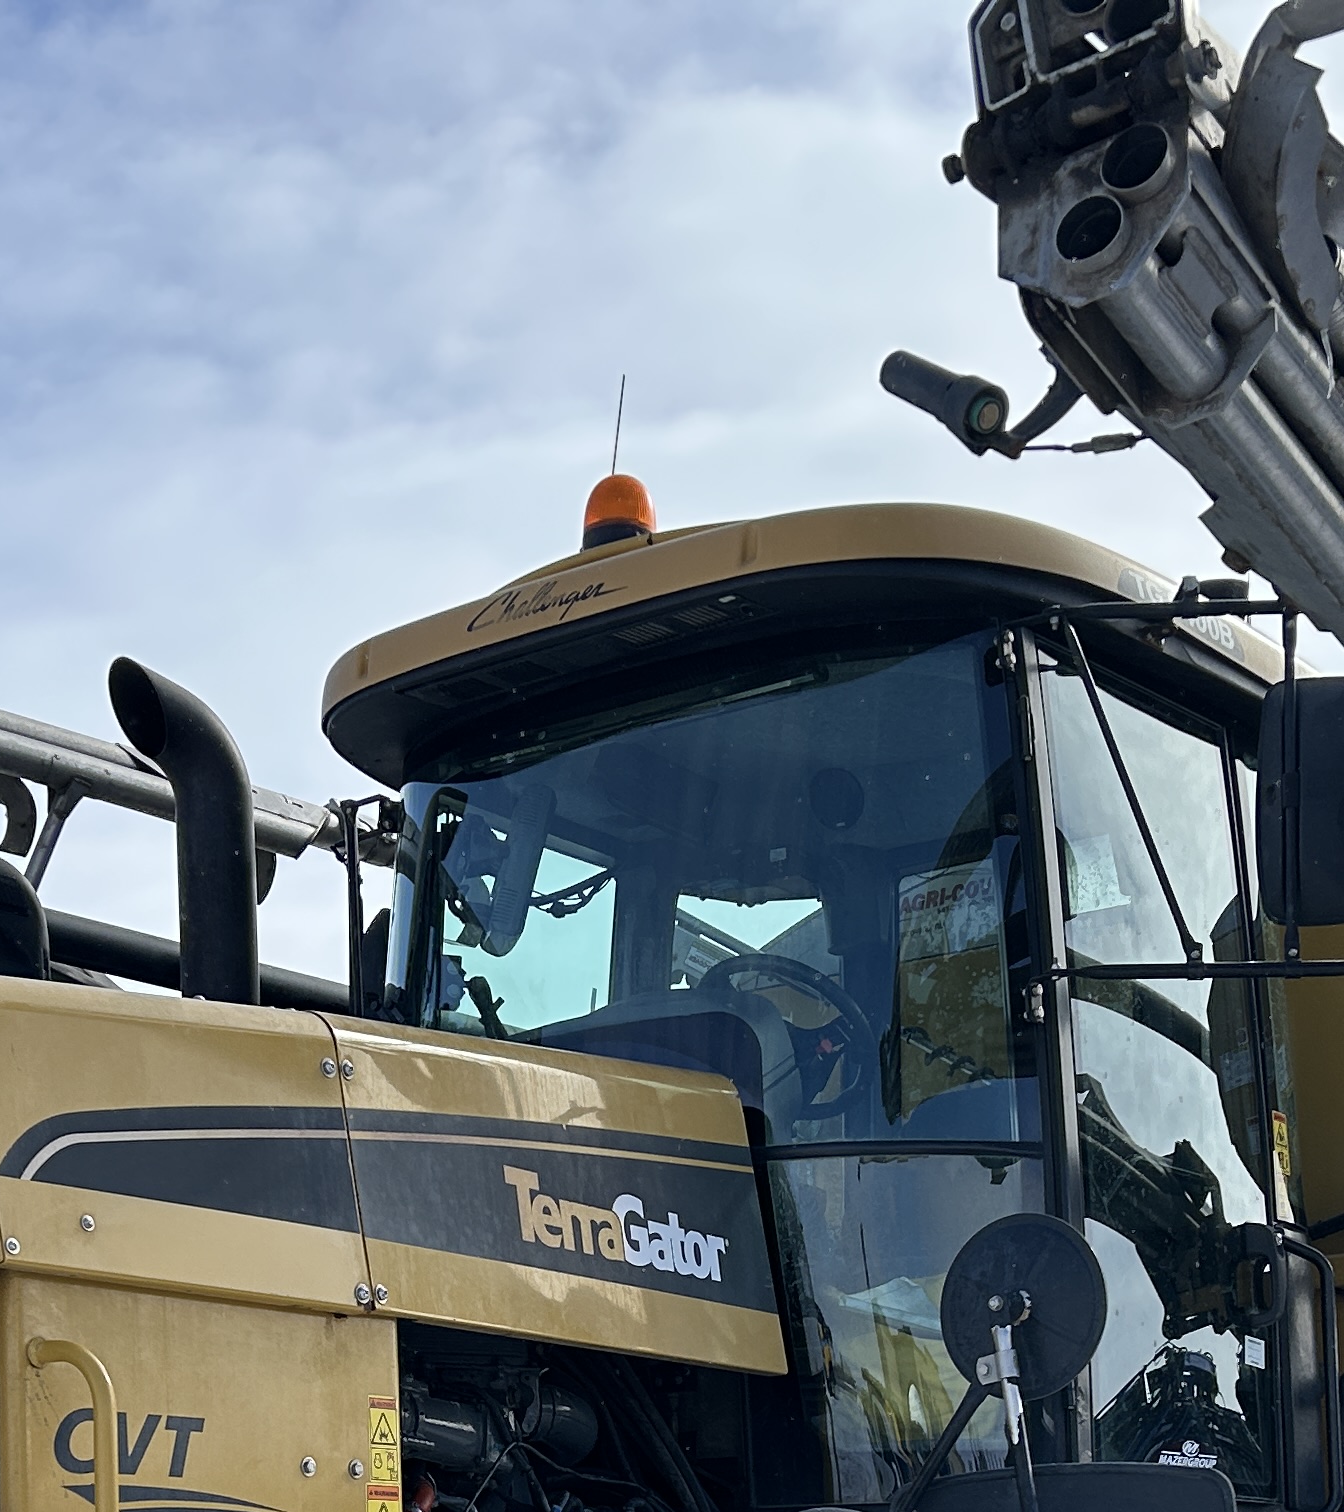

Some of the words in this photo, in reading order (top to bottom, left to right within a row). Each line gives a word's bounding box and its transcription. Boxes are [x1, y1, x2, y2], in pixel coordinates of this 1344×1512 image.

[466, 581, 629, 633] Challenger
[54, 1407, 206, 1478] CVT
[1158, 1454, 1218, 1469] MAZERGROUP
